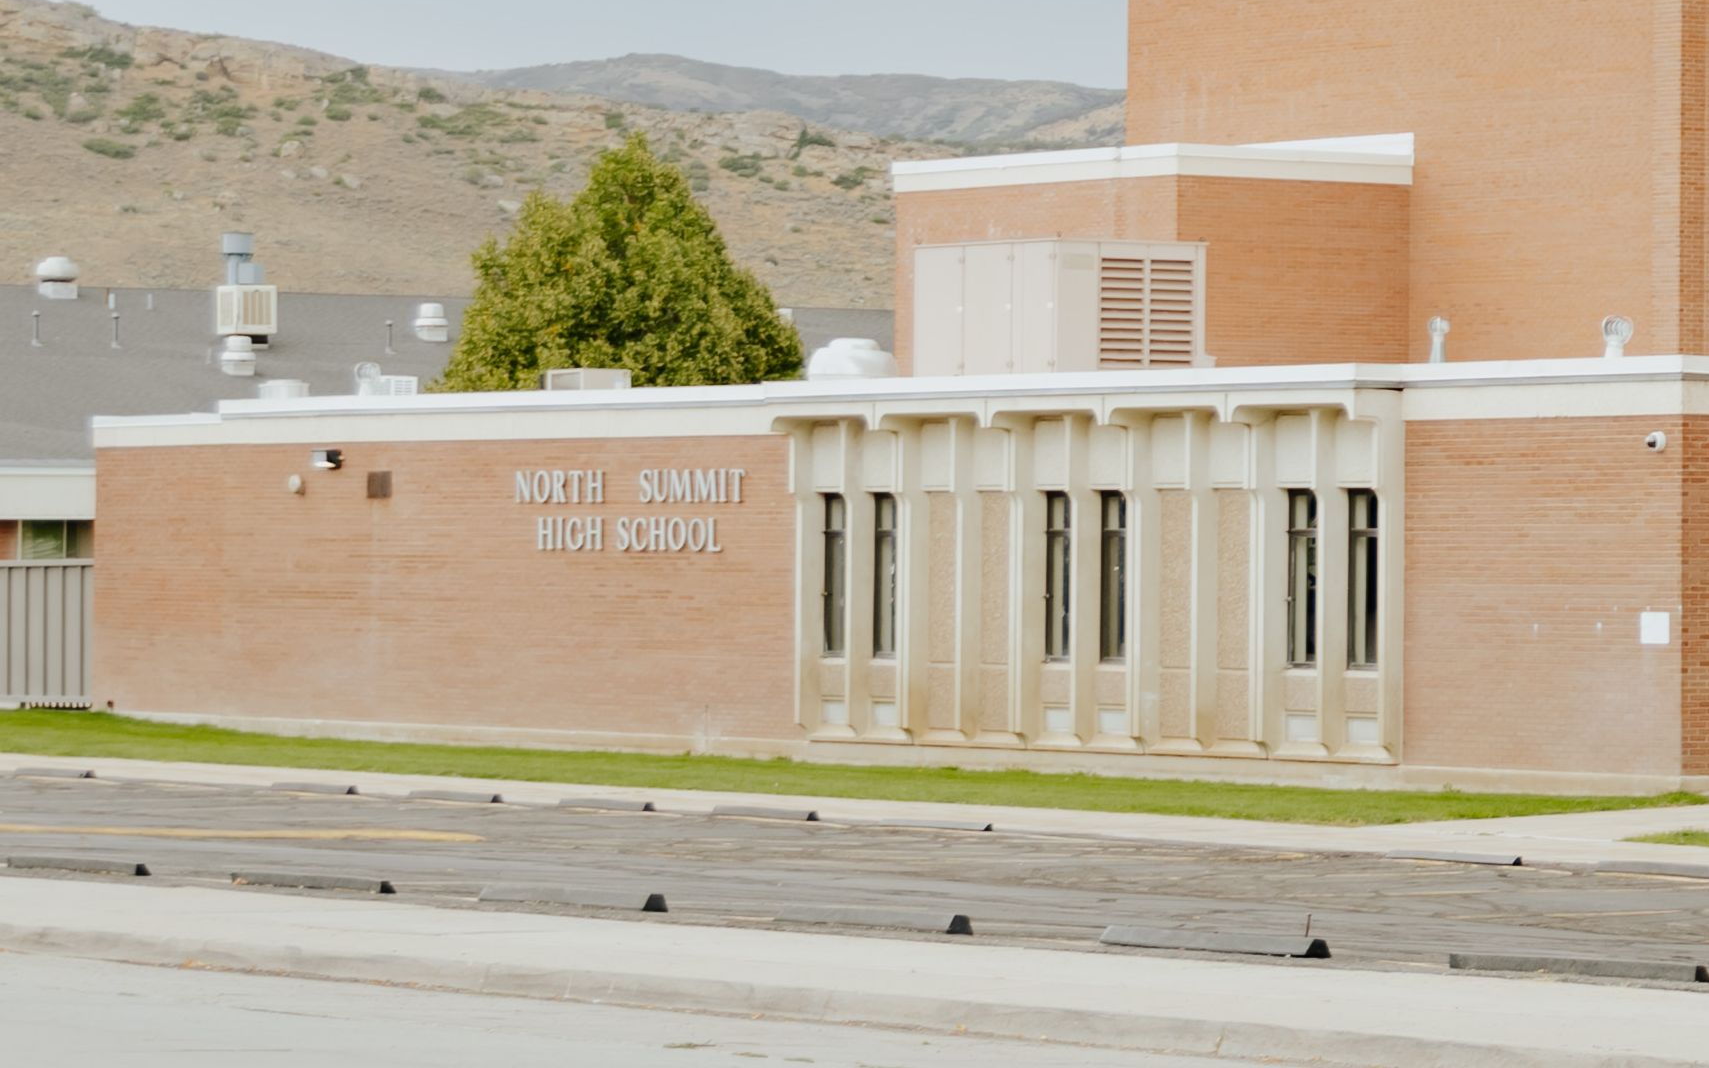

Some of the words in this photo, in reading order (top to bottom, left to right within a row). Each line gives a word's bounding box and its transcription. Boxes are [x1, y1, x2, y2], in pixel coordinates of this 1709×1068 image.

[515, 469, 605, 503] NORTH
[639, 468, 745, 503] SUMMIT
[537, 516, 603, 550] HIGH
[616, 516, 722, 552] SCHOOL
